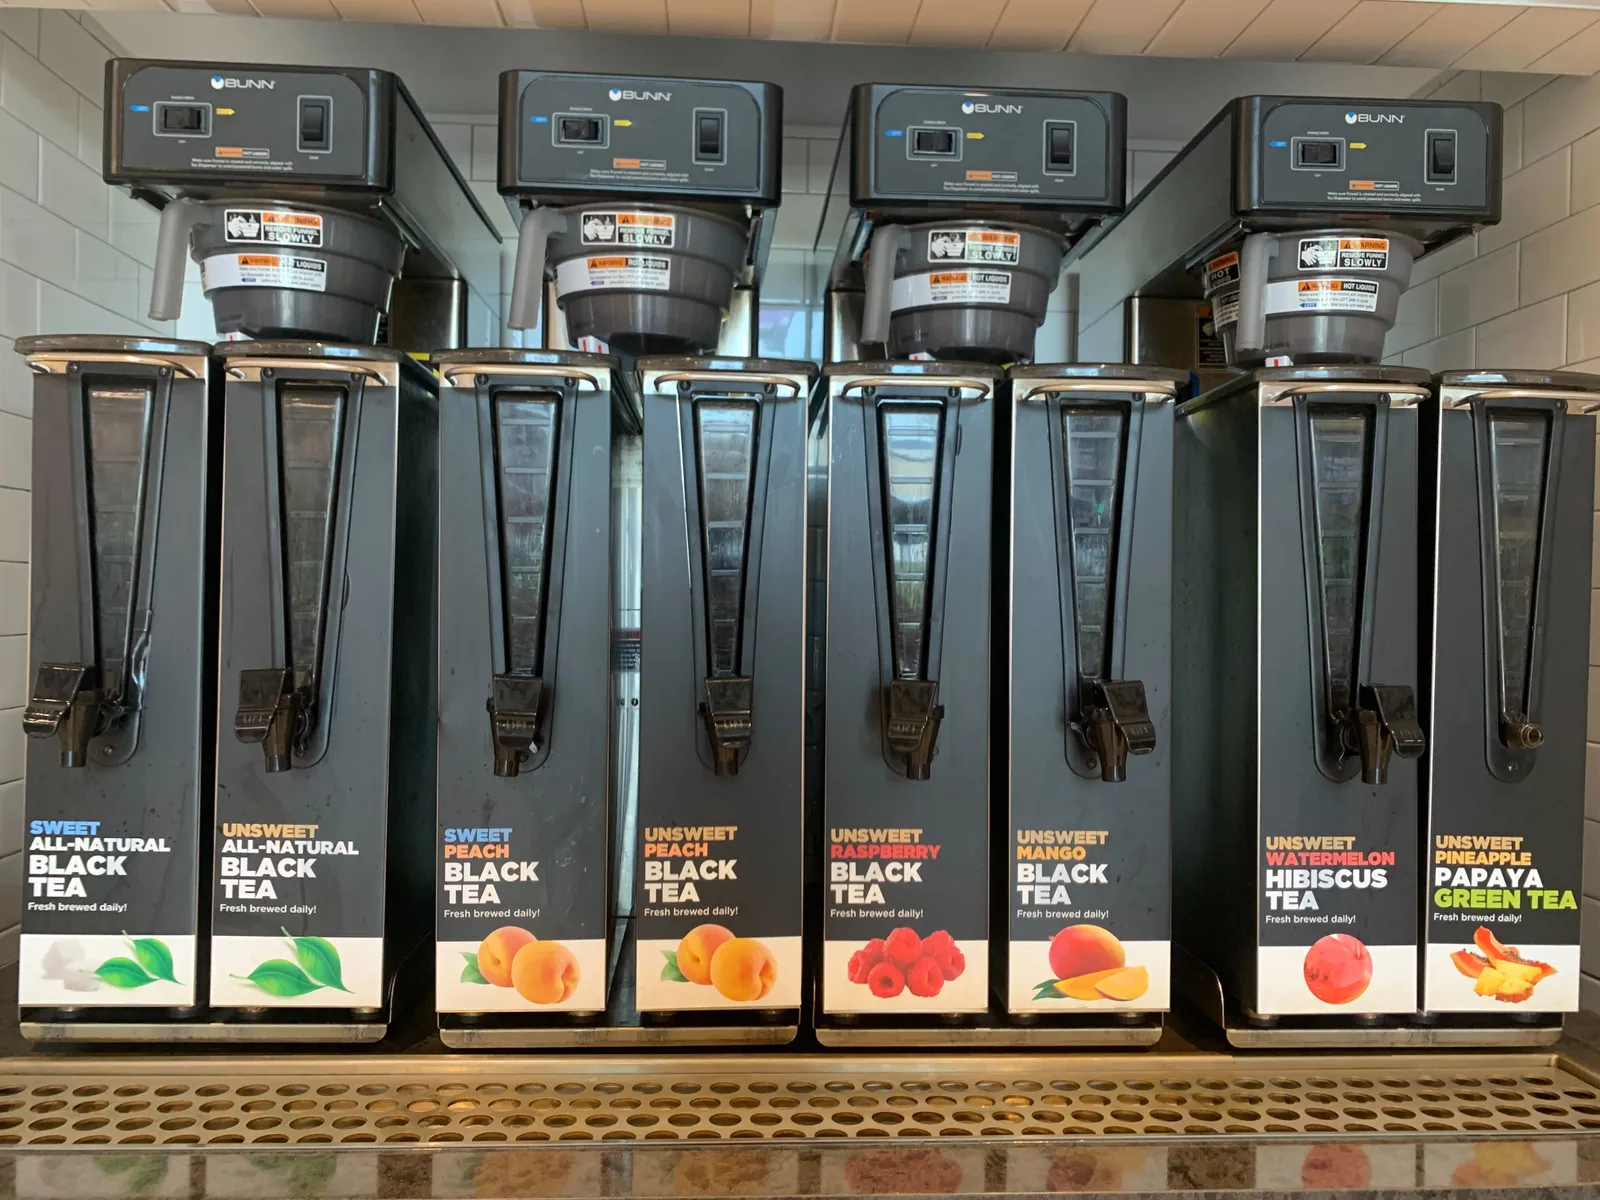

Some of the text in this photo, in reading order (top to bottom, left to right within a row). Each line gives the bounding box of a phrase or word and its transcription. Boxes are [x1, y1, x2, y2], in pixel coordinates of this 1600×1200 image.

[225, 79, 275, 89] BUNN
[622, 91, 671, 101] BUNN
[975, 104, 1022, 114] BUNN
[1357, 114, 1404, 123] BUNN
[269, 232, 314, 243] SLOWLY
[293, 227, 319, 235] FUNNEL
[622, 234, 666, 243] SLOWLY
[972, 252, 1011, 260] SLOWLY
[296, 261, 322, 270] LIQUIDS
[1212, 268, 1229, 281] HOT
[30, 820, 100, 836] SWEET
[223, 823, 319, 838] UNSWEET
[444, 828, 512, 843] SWEET
[644, 826, 737, 842] UNSWEET
[831, 828, 922, 843] UNSWEET
[29, 837, 170, 852] ALL-NATURAL
[1017, 830, 1109, 845] UNSWEET
[1266, 837, 1355, 850] UNSWEET
[1436, 835, 1523, 850] UNSWEET
[222, 839, 359, 855] ALL-NATURAL
[444, 844, 509, 859] PEACH
[644, 843, 708, 857] PEACH
[831, 844, 941, 859] RASPBERRY
[1017, 846, 1087, 860] MANGO
[29, 854, 127, 876] BLACK
[1266, 852, 1395, 866] WATERMELON
[1436, 851, 1532, 866] PINEAPPLE
[221, 857, 317, 878] BLACK
[444, 861, 539, 882] BLACK
[645, 859, 737, 881] BLACK
[831, 862, 922, 882] BLACK
[1017, 863, 1108, 883] BLACK
[1266, 869, 1388, 889] HIBISCUS
[1435, 867, 1543, 888] PAPAYA
[28, 877, 87, 897] TEA
[220, 879, 277, 899] TEA
[444, 884, 501, 904] TEA
[644, 882, 700, 903] TEA
[830, 883, 886, 904] TEA
[1017, 885, 1071, 905] TEA
[1266, 891, 1319, 910] TEA
[1434, 888, 1578, 909] GREEN TEA
[28, 902, 127, 913] Fresh brewed daily!
[220, 904, 316, 914] Fresh brewed daily!
[444, 908, 540, 918] Fresh brewed daily!
[644, 906, 738, 917] Fresh brewed daily!
[830, 909, 924, 919] Fresh brewed daily!
[1017, 910, 1109, 919] Fresh brewed daily!
[1265, 915, 1356, 924] Fresh brewed daily!
[1433, 913, 1522, 924] Fresh brewed daily!
